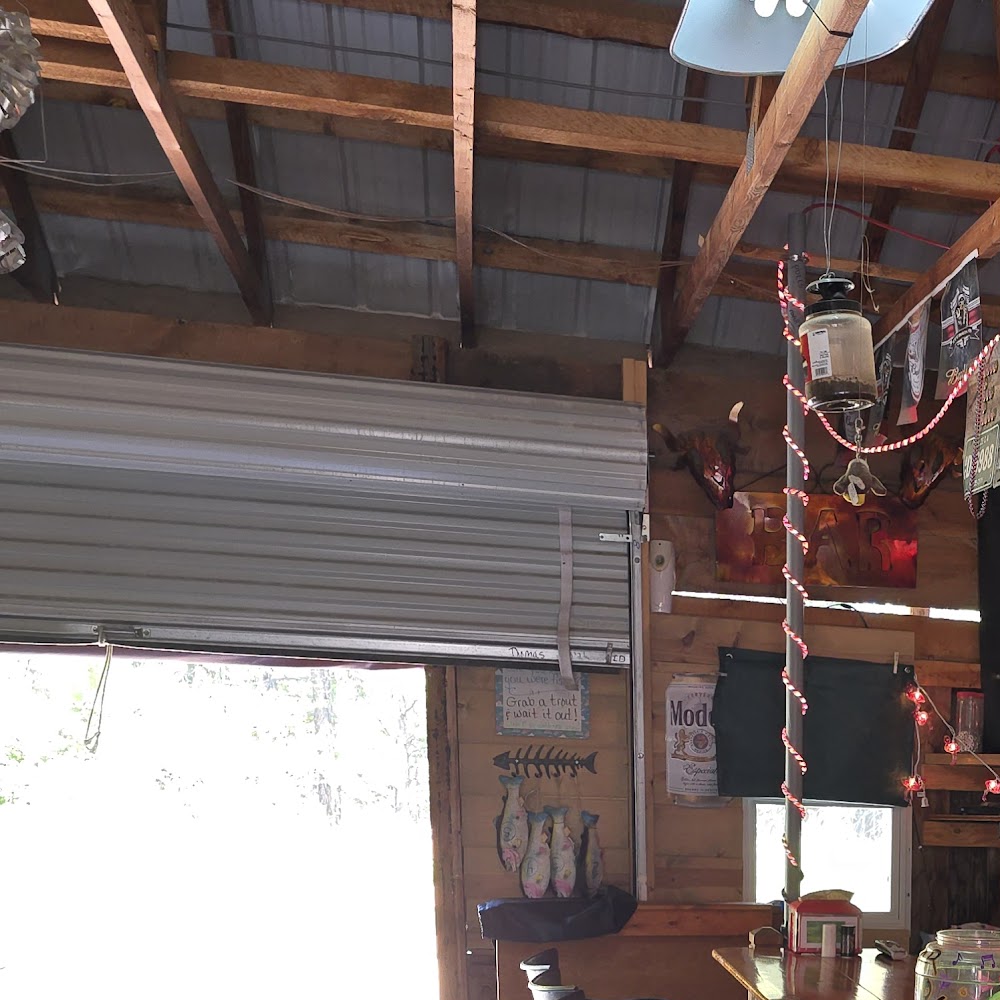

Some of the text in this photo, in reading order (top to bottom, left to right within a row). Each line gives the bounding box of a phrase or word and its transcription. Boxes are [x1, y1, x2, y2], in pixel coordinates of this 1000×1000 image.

[506, 694, 578, 707] Grab a trout
[514, 708, 537, 718] wait
[542, 708, 552, 719] it
[671, 700, 713, 727] Mod
